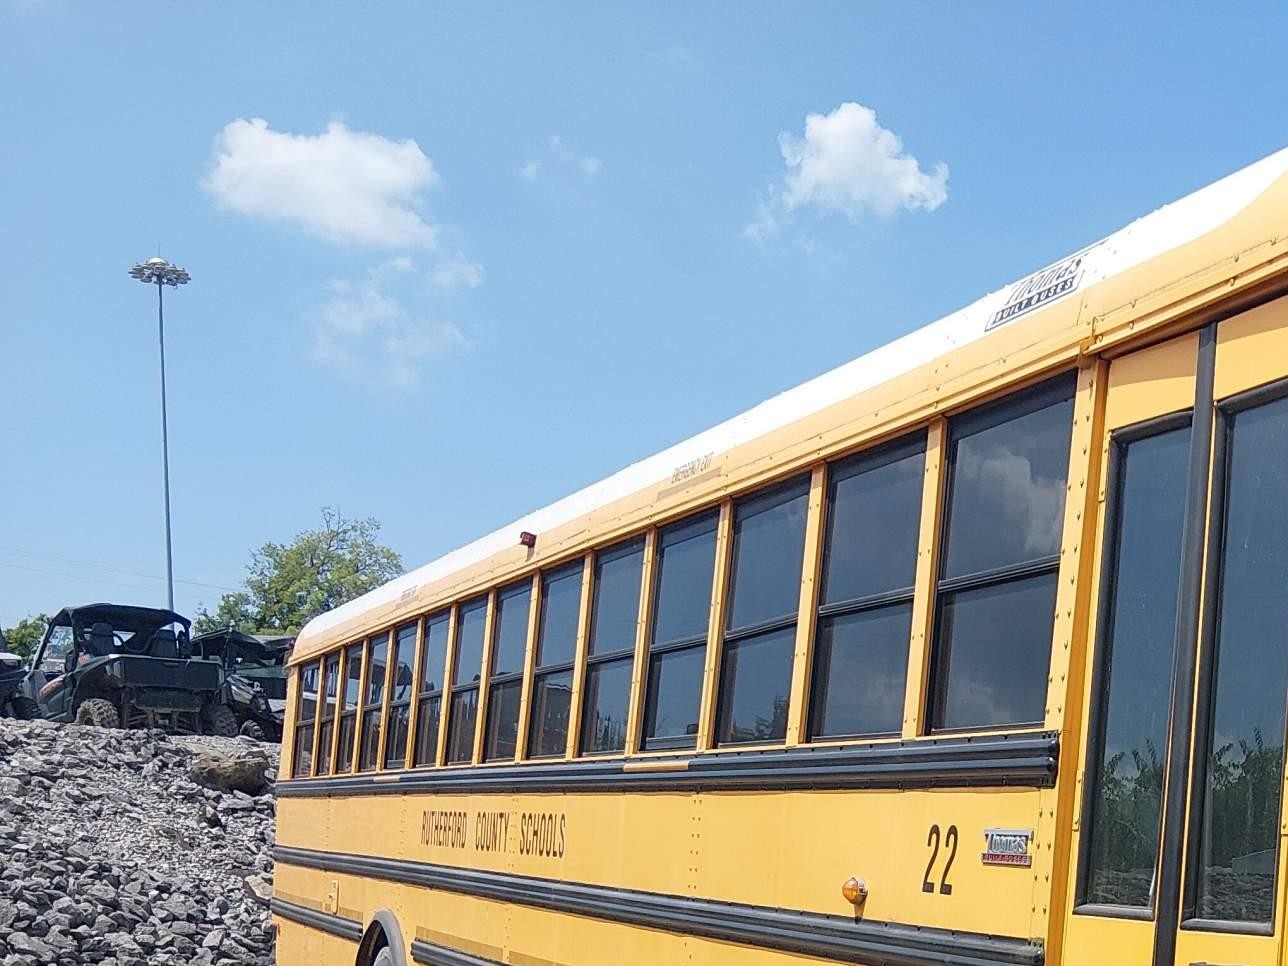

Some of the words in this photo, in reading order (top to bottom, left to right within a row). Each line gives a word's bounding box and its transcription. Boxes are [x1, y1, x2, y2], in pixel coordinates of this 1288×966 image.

[421, 810, 467, 849] RUTHERFORD
[475, 811, 510, 853] COUNTY
[519, 812, 567, 859] SCHOOLS
[921, 823, 959, 896] 22
